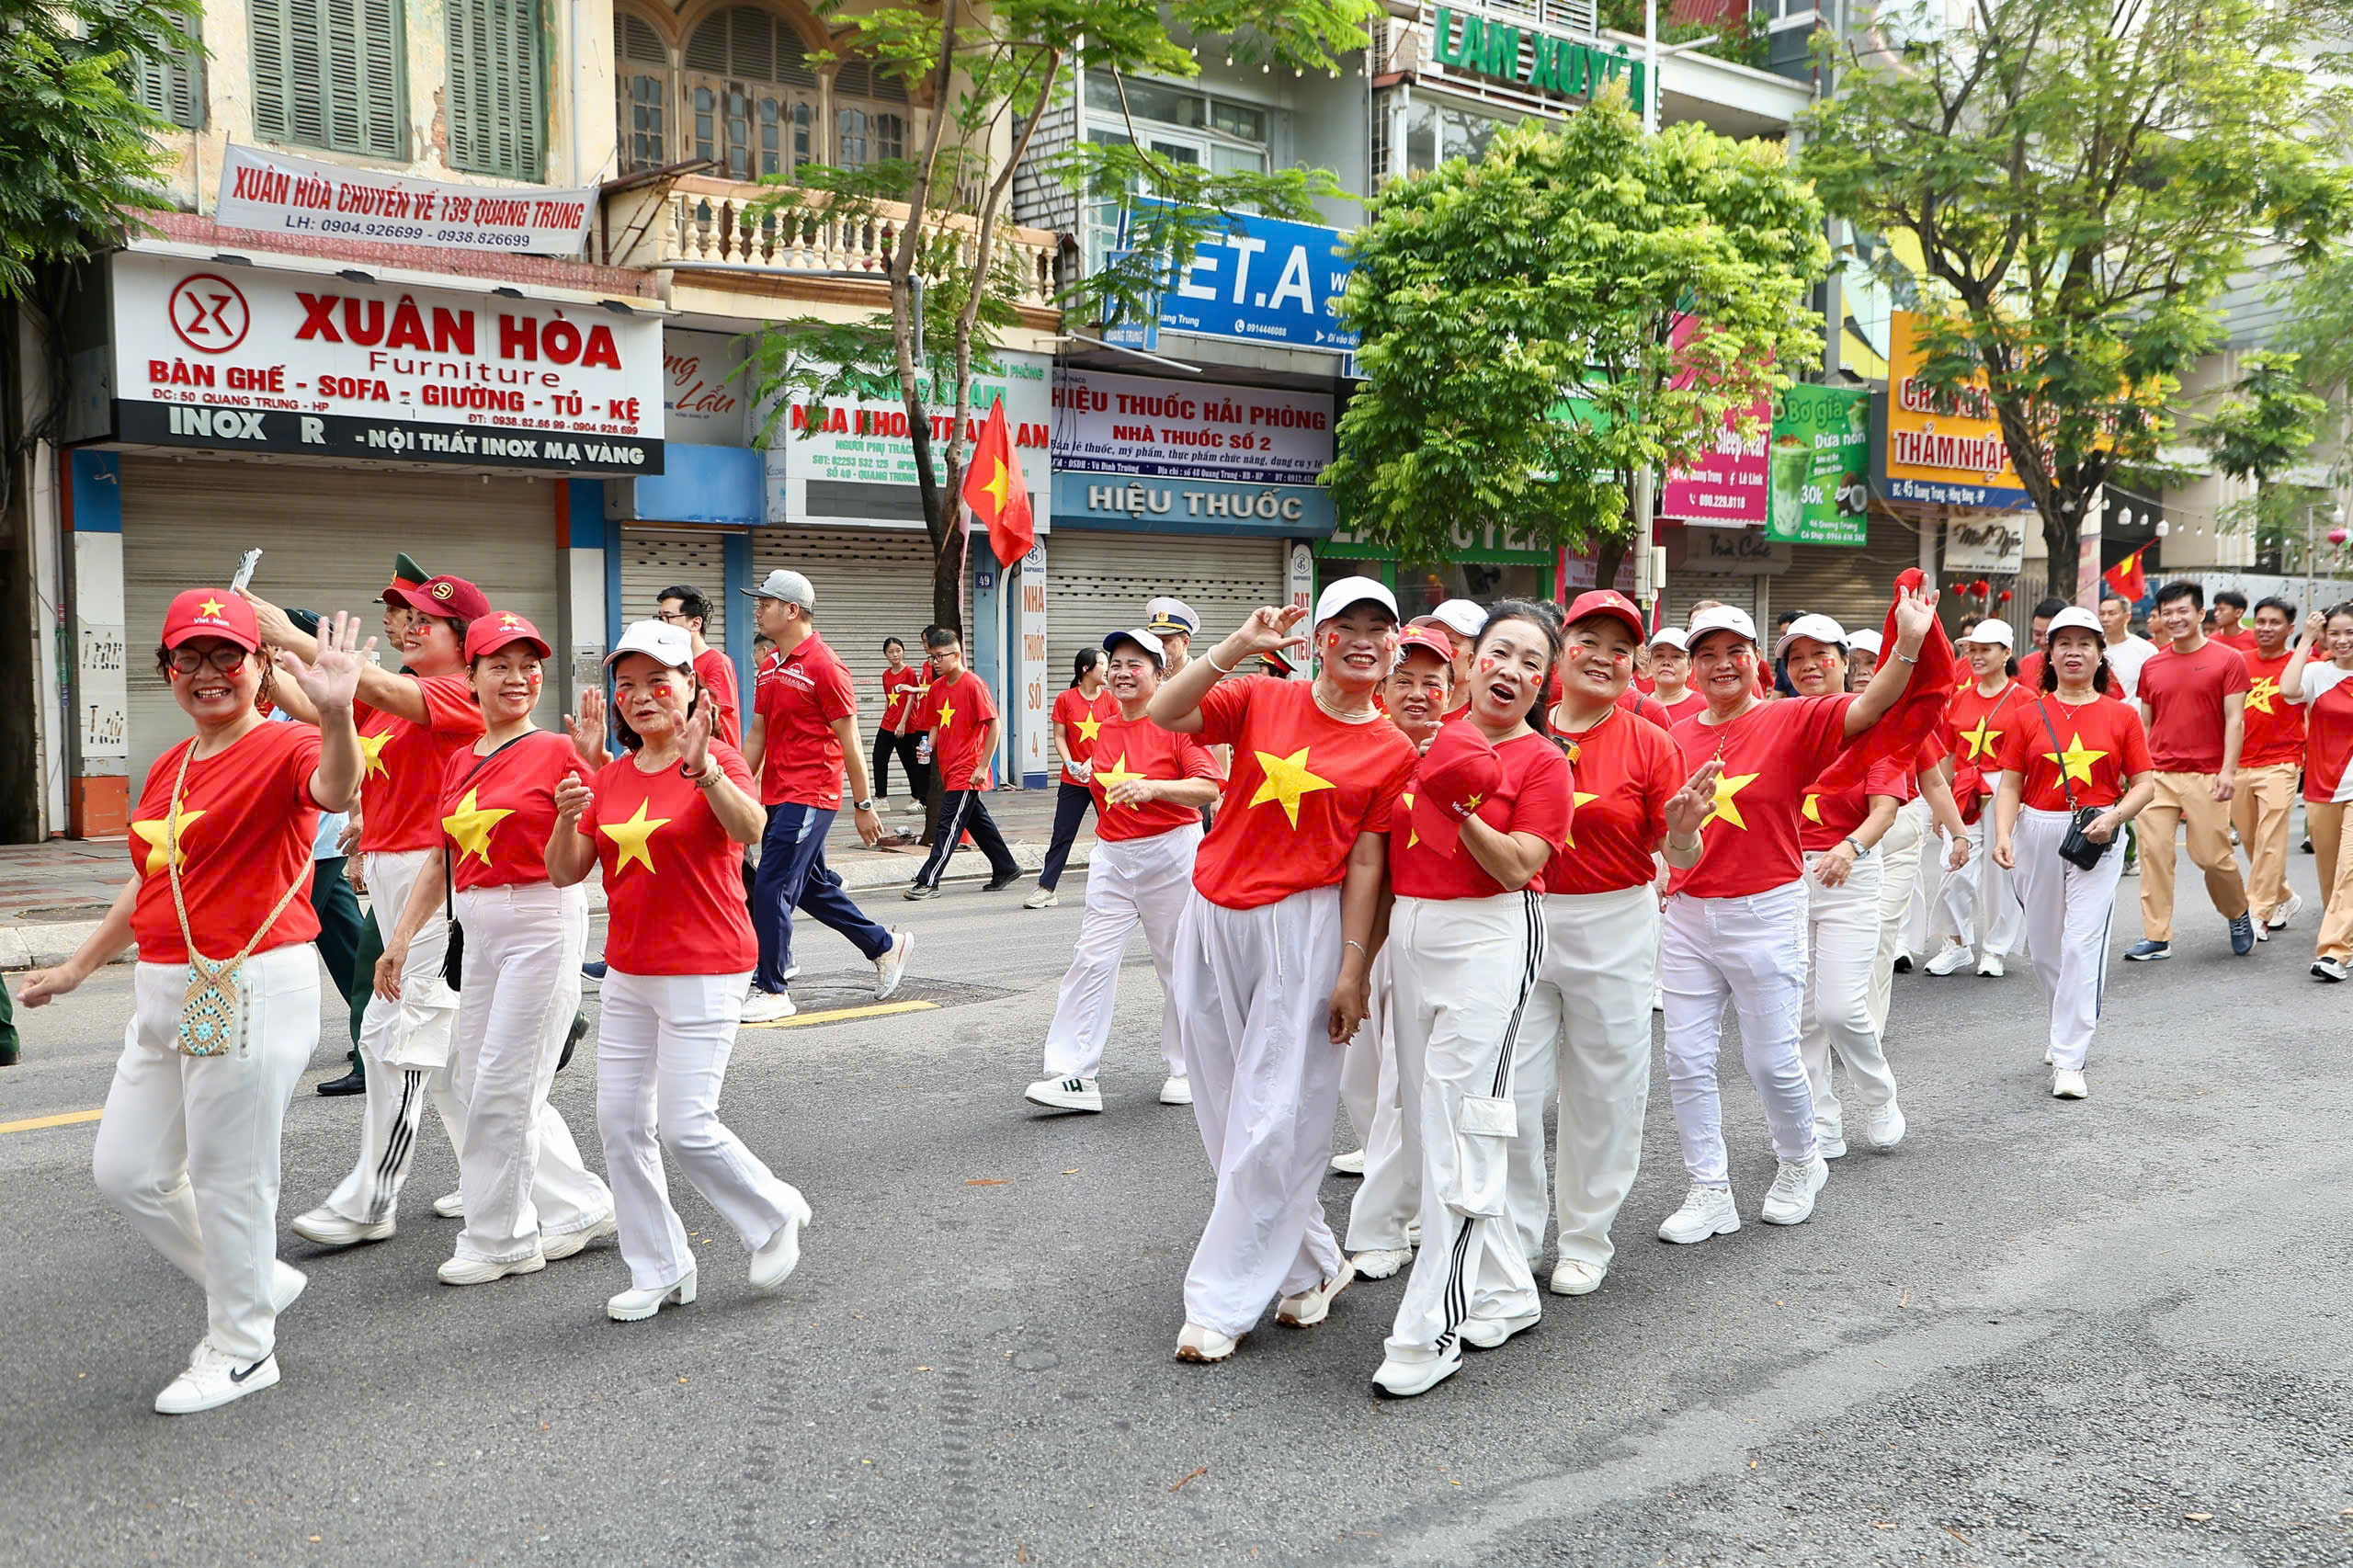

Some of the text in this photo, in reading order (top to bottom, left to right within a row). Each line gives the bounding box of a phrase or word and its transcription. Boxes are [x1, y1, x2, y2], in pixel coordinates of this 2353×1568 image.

[1433, 7, 1519, 81] LAN
[233, 164, 290, 205] XUÂN
[292, 171, 332, 210] HÒA
[441, 196, 472, 222] 139
[473, 199, 530, 227] QUANG
[532, 201, 585, 229] TRUNG
[286, 214, 530, 247] LH: 0904.926699 0938.826699
[294, 291, 622, 369] XUÂN HÒA
[1178, 313, 1199, 327] Trung
[369, 351, 561, 388] Furniture
[149, 357, 641, 425] BÀN GHẾ SOFA GIƯỜNG TỦ KỆ
[180, 392, 196, 403] 50
[202, 392, 251, 406] QUANG
[255, 397, 299, 410] TRUNG
[313, 402, 329, 412] HP
[1116, 392, 1195, 420] THUỐC
[1204, 397, 1243, 424] HẢI
[1250, 404, 1325, 430] PHÒNG
[1788, 398, 1811, 424] Bơ
[169, 406, 267, 440] INOX
[301, 415, 326, 445] R
[419, 428, 477, 454] THẤT
[482, 437, 539, 459] INOX
[544, 441, 582, 465] MẠ
[584, 441, 645, 465] VÀNG
[1016, 422, 1050, 449] AN
[1113, 425, 1271, 451] NHÀ THUỐC SỐ 2
[1843, 432, 1866, 446] non
[858, 470, 888, 481] QUANG
[889, 472, 916, 483] TRUNG
[1088, 482, 1302, 520] HIỆU THUỐC
[1802, 485, 1824, 505] 30k
[979, 575, 991, 586] 49
[1023, 579, 1045, 613] NHÀ
[1023, 624, 1045, 662] THUỐC
[1028, 673, 1041, 710] SỐ
[1031, 732, 1039, 758] 4
